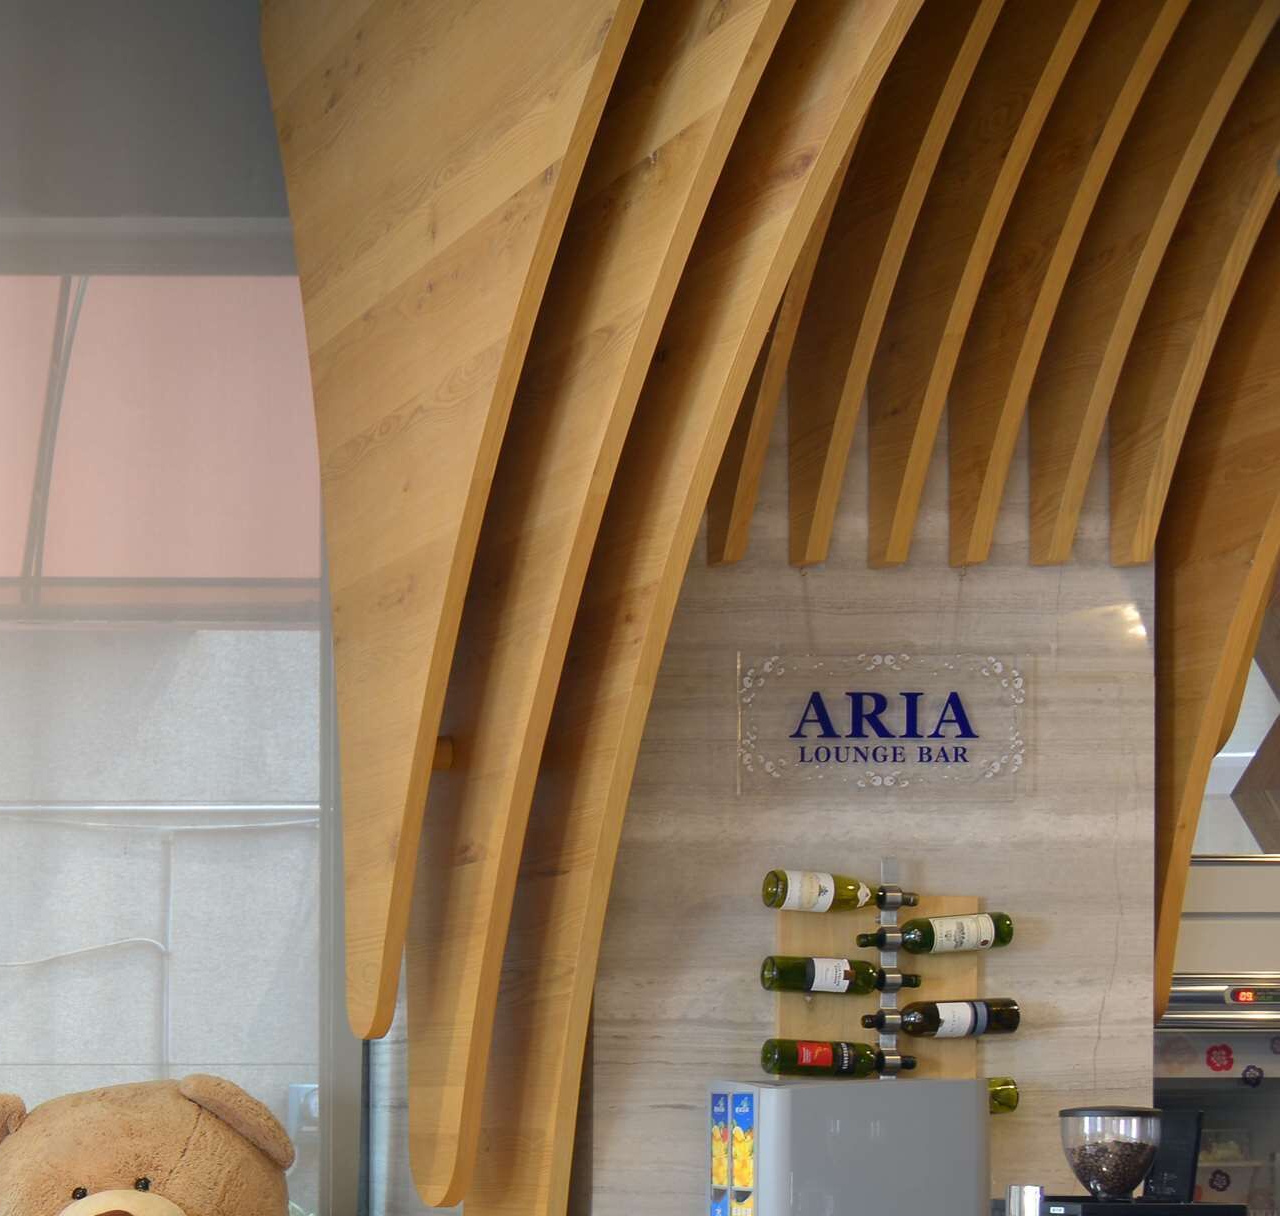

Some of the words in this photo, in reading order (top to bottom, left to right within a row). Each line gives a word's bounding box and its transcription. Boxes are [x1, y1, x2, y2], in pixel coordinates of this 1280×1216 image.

[789, 691, 979, 739] ARIA
[799, 745, 906, 763] LOUNGE
[918, 745, 969, 763] BAR
